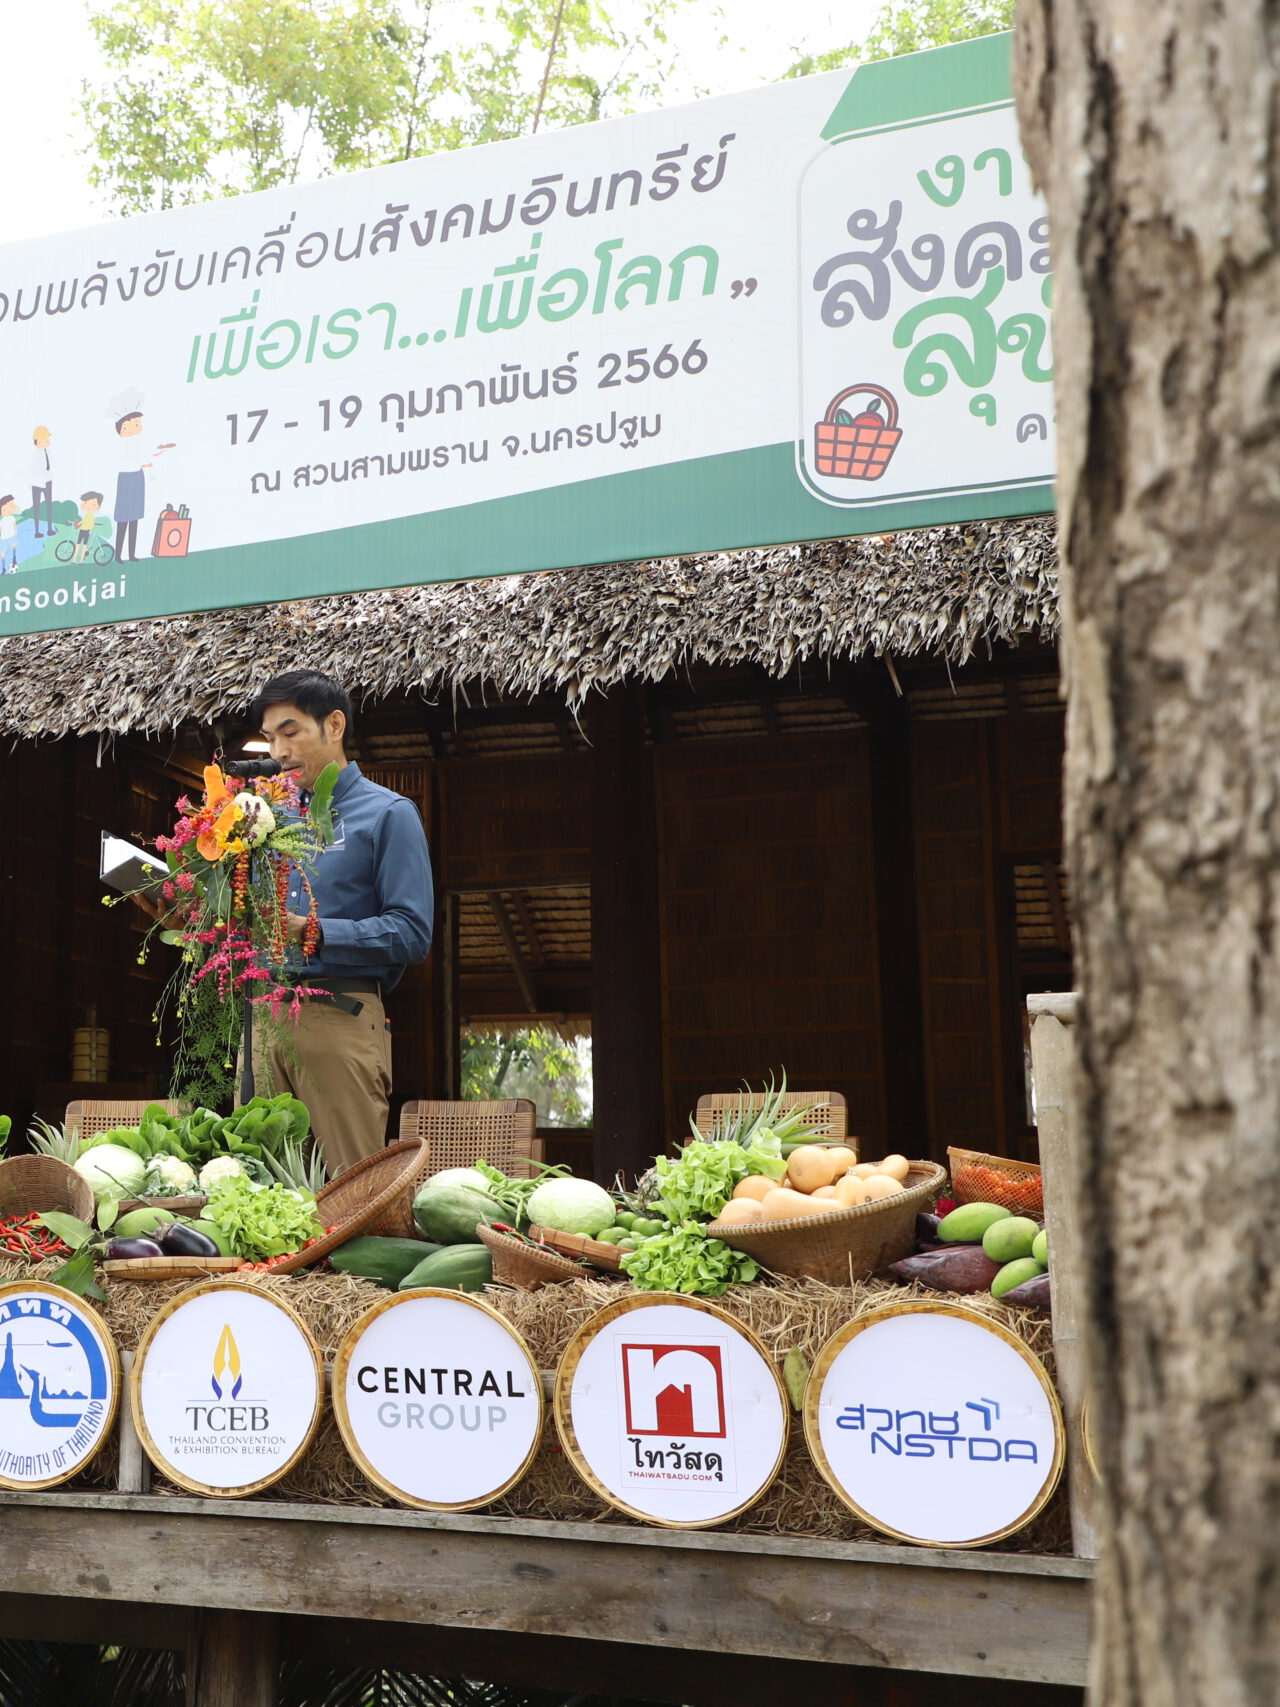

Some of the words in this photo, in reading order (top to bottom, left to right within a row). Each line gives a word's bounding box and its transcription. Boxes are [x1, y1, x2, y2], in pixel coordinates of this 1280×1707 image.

[916, 148, 1028, 208] งา
[226, 409, 269, 446] 17
[318, 395, 363, 432] 19
[379, 351, 579, 434] กุมภาพันธ์
[597, 339, 709, 389] 2566
[250, 469, 281, 494] ณ
[293, 438, 489, 489] สวนสามพราน
[501, 411, 662, 457] จ.นครปฐม
[357, 1365, 525, 1398] CENTRAL
[185, 1406, 270, 1432] TCEB
[377, 1401, 507, 1433] GROUP
[52, 1445, 67, 1469] OF
[65, 1400, 104, 1458] THAILAND
[169, 1435, 218, 1445] THAILAND
[220, 1435, 287, 1445] CONVENTION
[173, 1445, 180, 1455] &
[183, 1445, 238, 1455] EXHIBITION
[241, 1445, 280, 1455] BUREAU
[870, 1432, 1038, 1464] NSTDA
[627, 1437, 723, 1482] ไทวัสดุ
[628, 1471, 713, 1481] THAIWATSADU.COM
